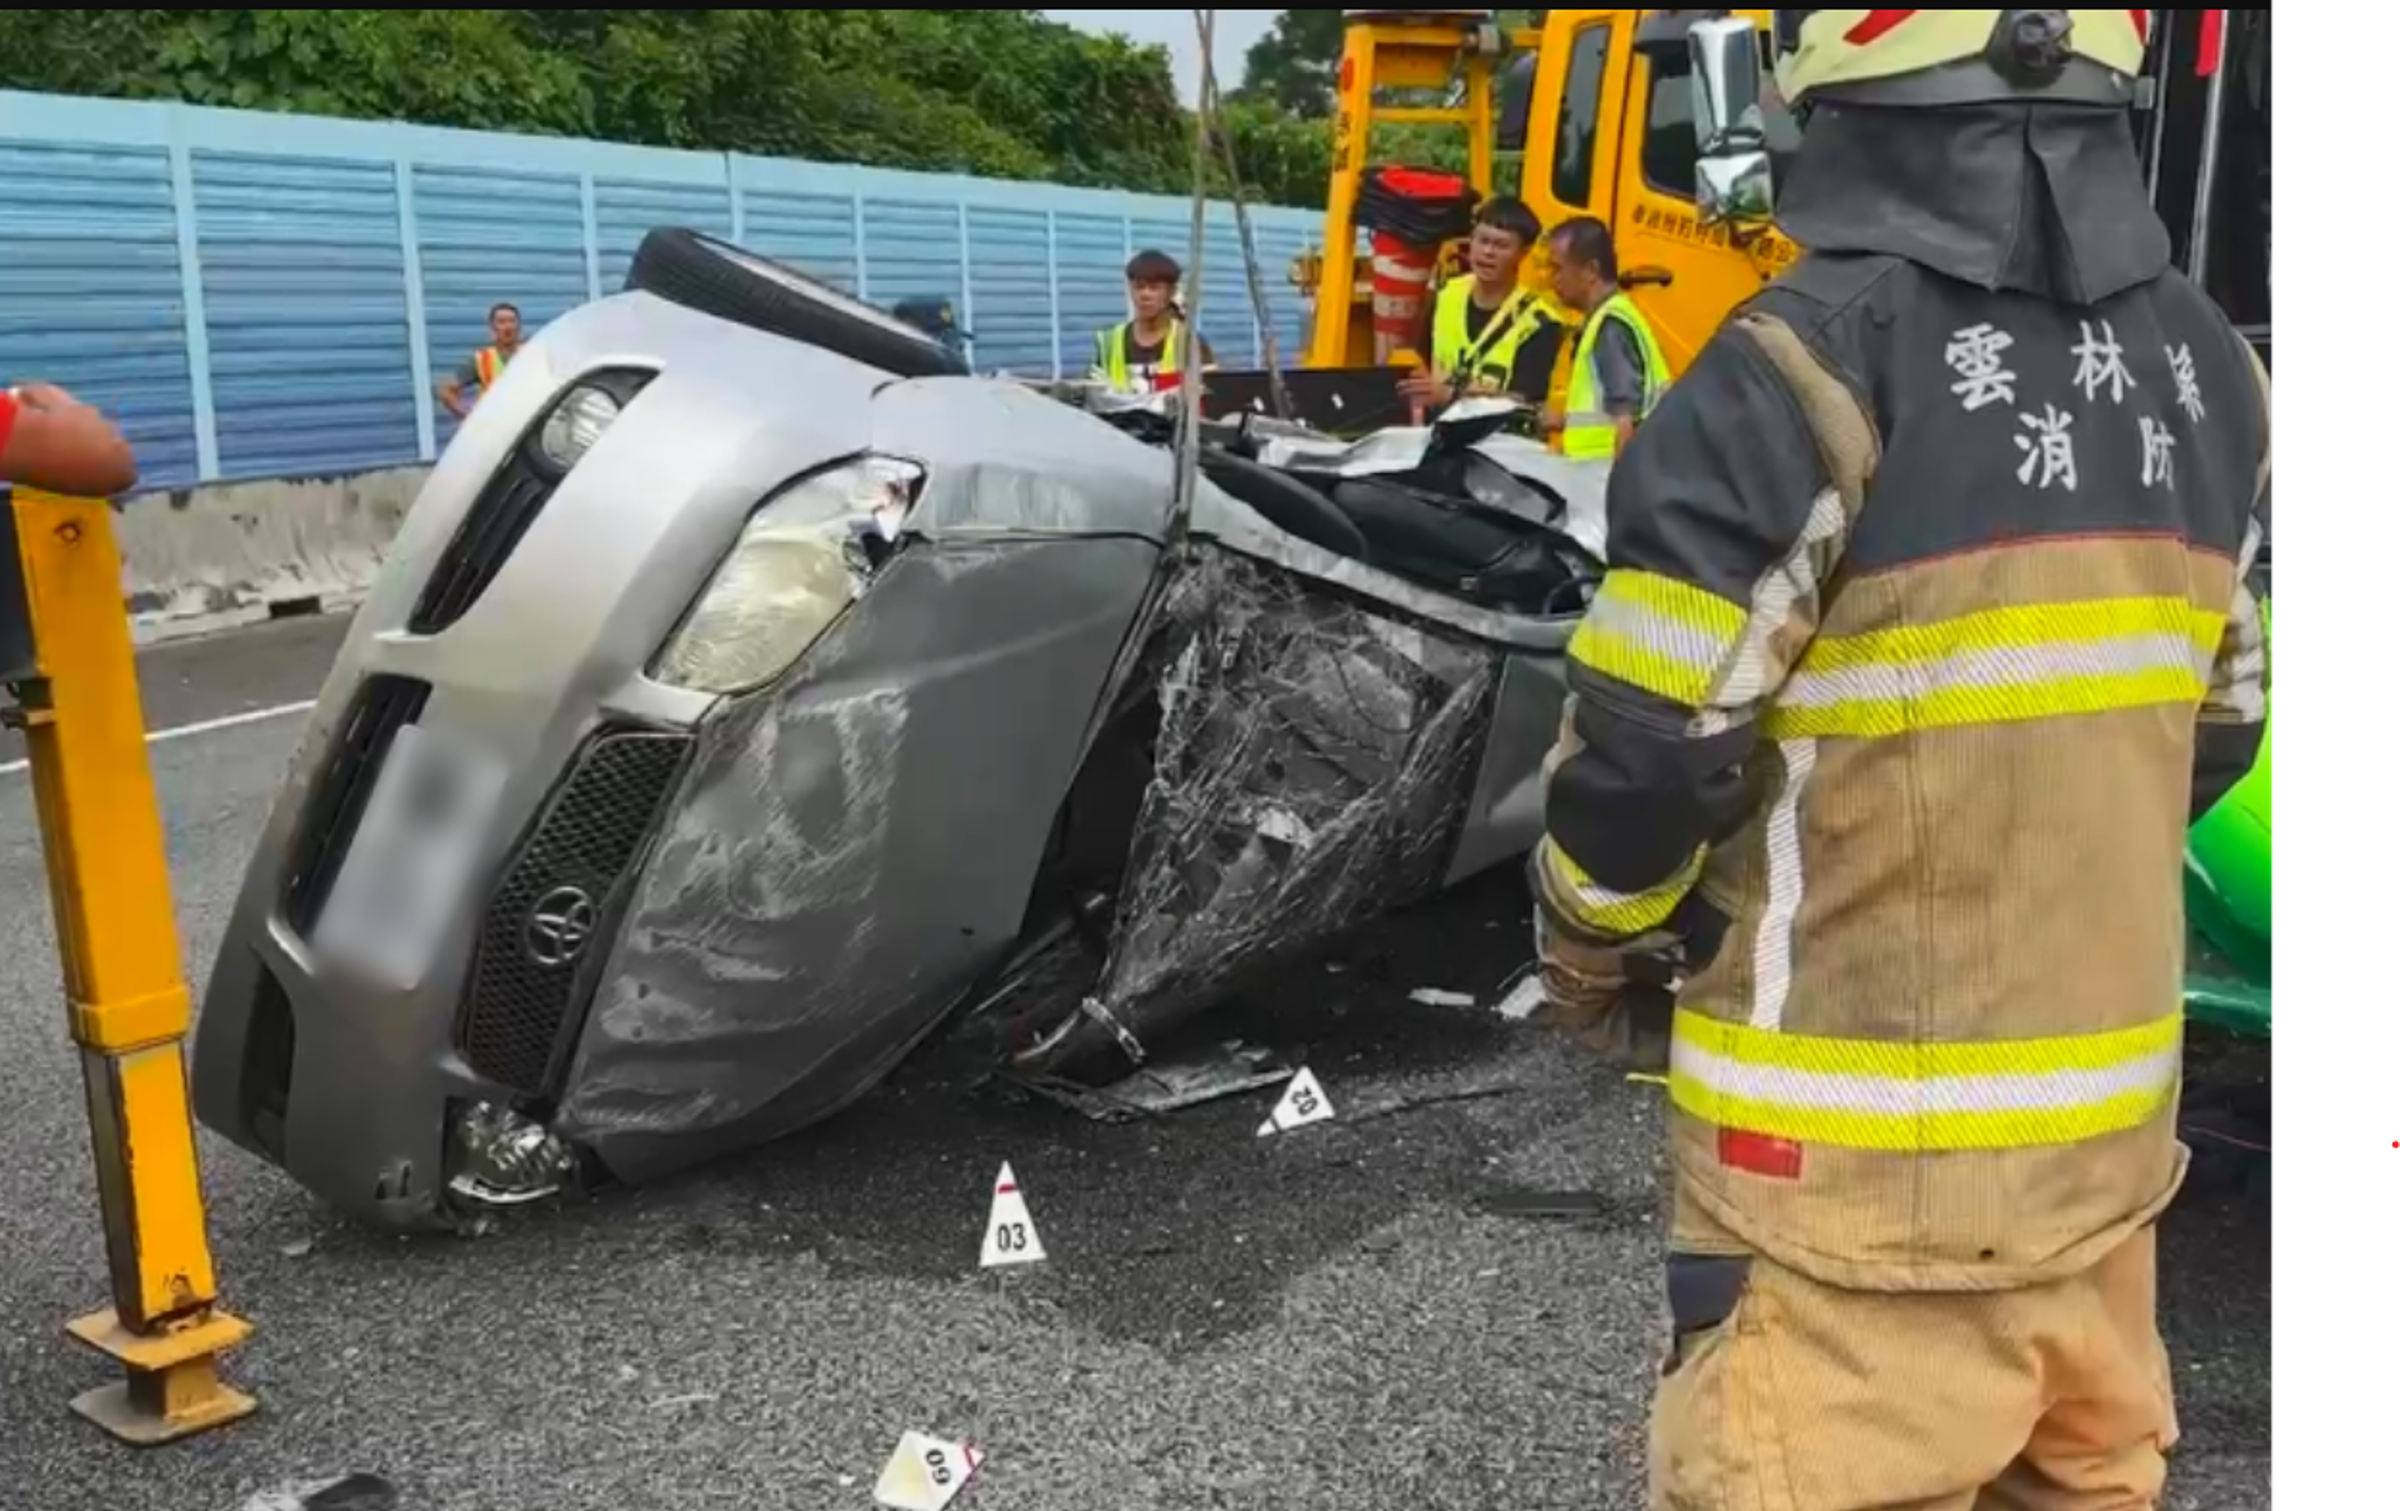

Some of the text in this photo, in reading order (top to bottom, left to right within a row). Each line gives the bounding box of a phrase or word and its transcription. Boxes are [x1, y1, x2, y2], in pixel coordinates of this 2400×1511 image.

[2013, 403, 2176, 491] 消防
[1291, 1085, 1318, 1116] 02
[997, 1222, 1027, 1253] 03
